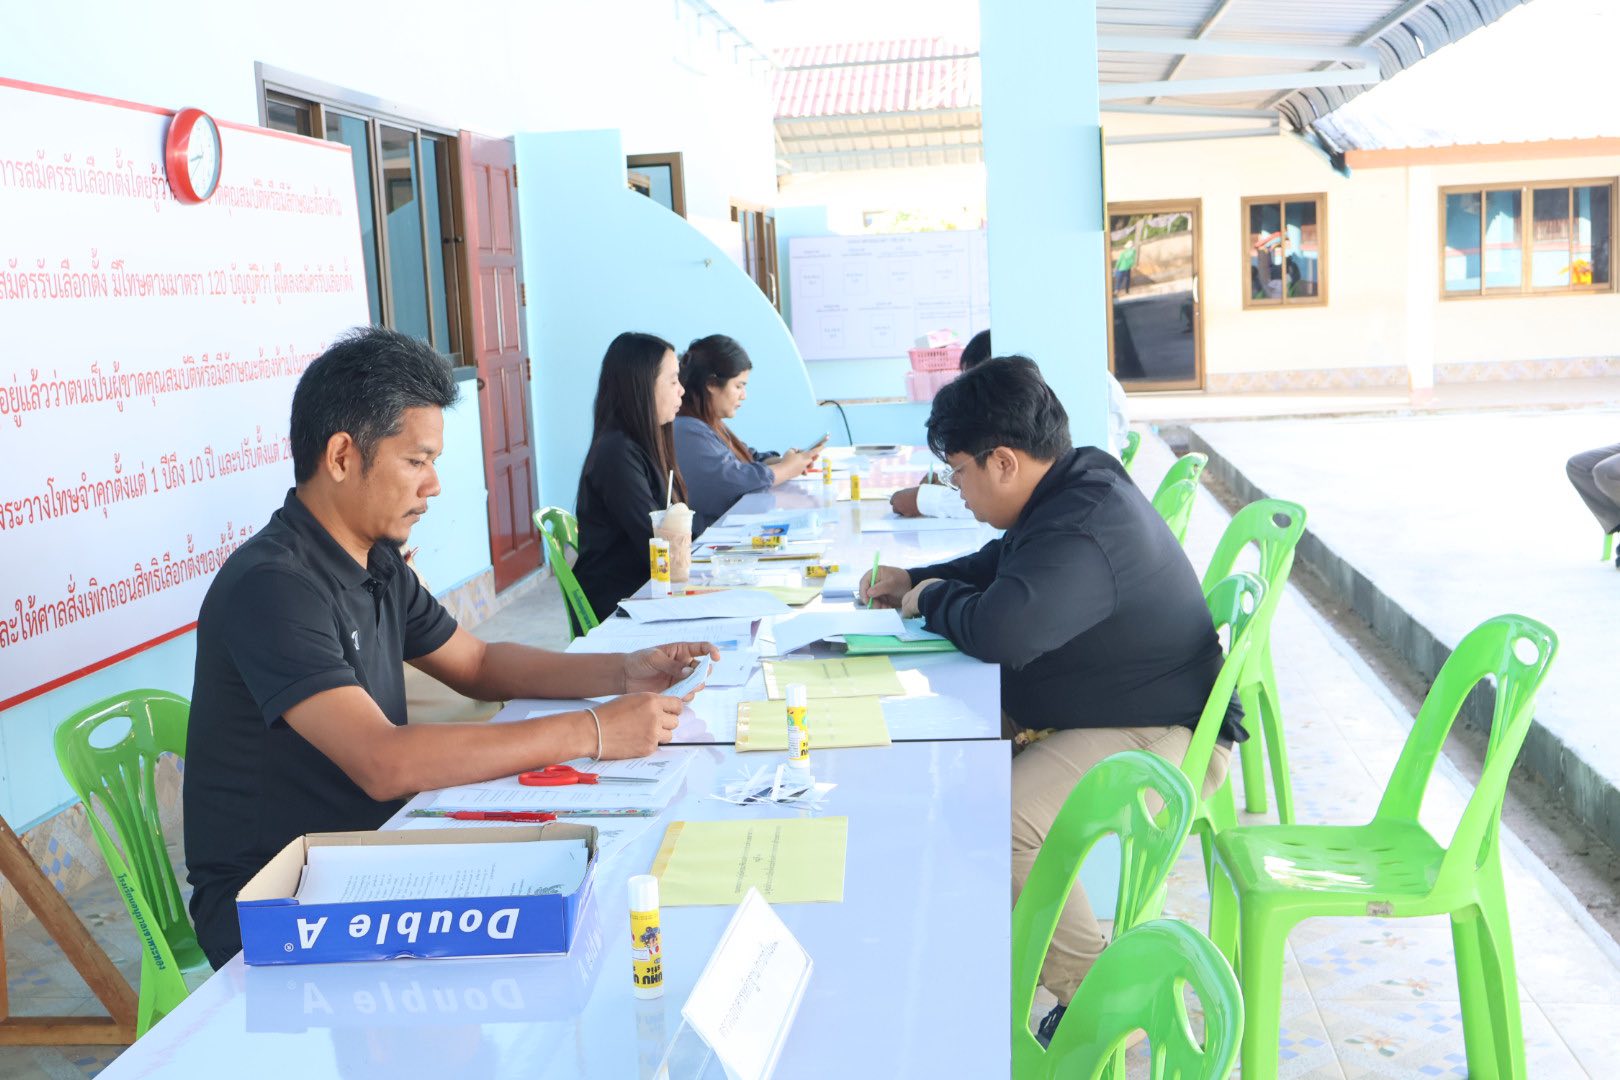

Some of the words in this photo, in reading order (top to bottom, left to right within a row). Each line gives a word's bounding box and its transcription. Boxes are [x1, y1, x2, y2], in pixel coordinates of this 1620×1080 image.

[208, 271, 227, 296] 120
[151, 466, 159, 493] 1
[160, 451, 186, 491] ปีถึง
[188, 455, 203, 484] 10
[204, 443, 216, 479] ปี
[297, 916, 329, 950] A
[348, 908, 520, 945] Double
[642, 972, 663, 985] UHU
